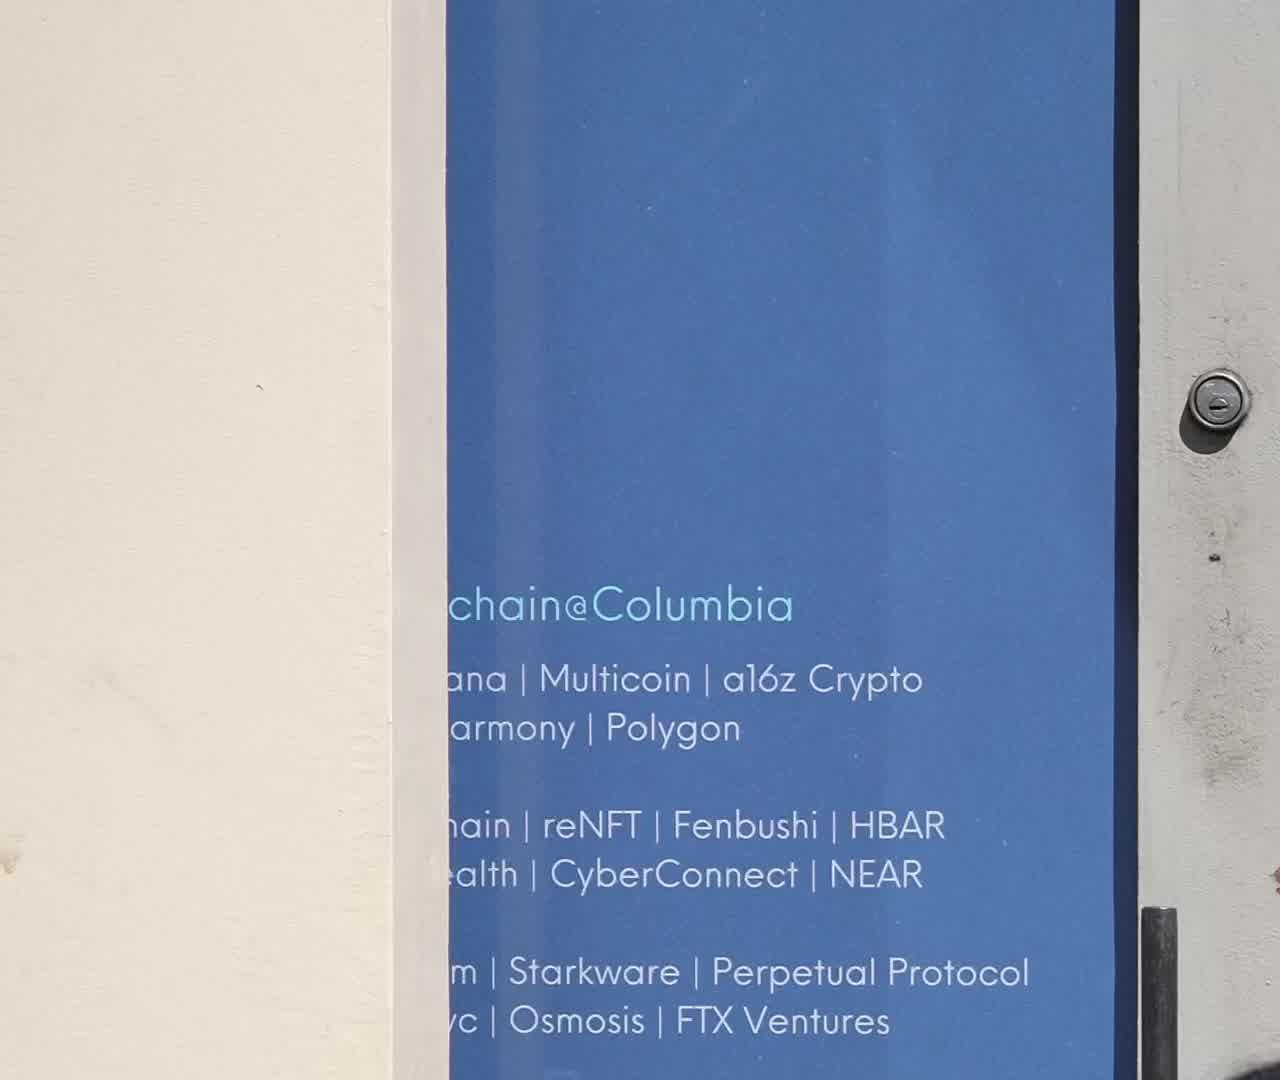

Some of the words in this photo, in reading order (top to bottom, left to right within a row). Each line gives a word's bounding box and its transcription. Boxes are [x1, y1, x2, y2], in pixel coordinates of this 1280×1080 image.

[448, 584, 793, 622] chain@Columbia
[447, 671, 507, 693] ana
[541, 663, 691, 693] Multicoin
[723, 663, 797, 693] a16z
[809, 664, 923, 702] Crypto
[450, 720, 576, 750] armony
[607, 712, 741, 750] Polygon
[544, 810, 643, 839] reNFT
[674, 809, 817, 840] Fenbushi
[851, 811, 945, 839] HBAR
[448, 859, 518, 888] alth
[551, 857, 799, 897] CyberConnect
[831, 859, 924, 888] NEAR
[509, 956, 681, 985] Starkware
[713, 957, 876, 995] Perpetual
[888, 957, 1029, 986] Protocol
[509, 1004, 645, 1034] Osmosis
[677, 1005, 734, 1034] FTX
[743, 1005, 890, 1035] Ventures
